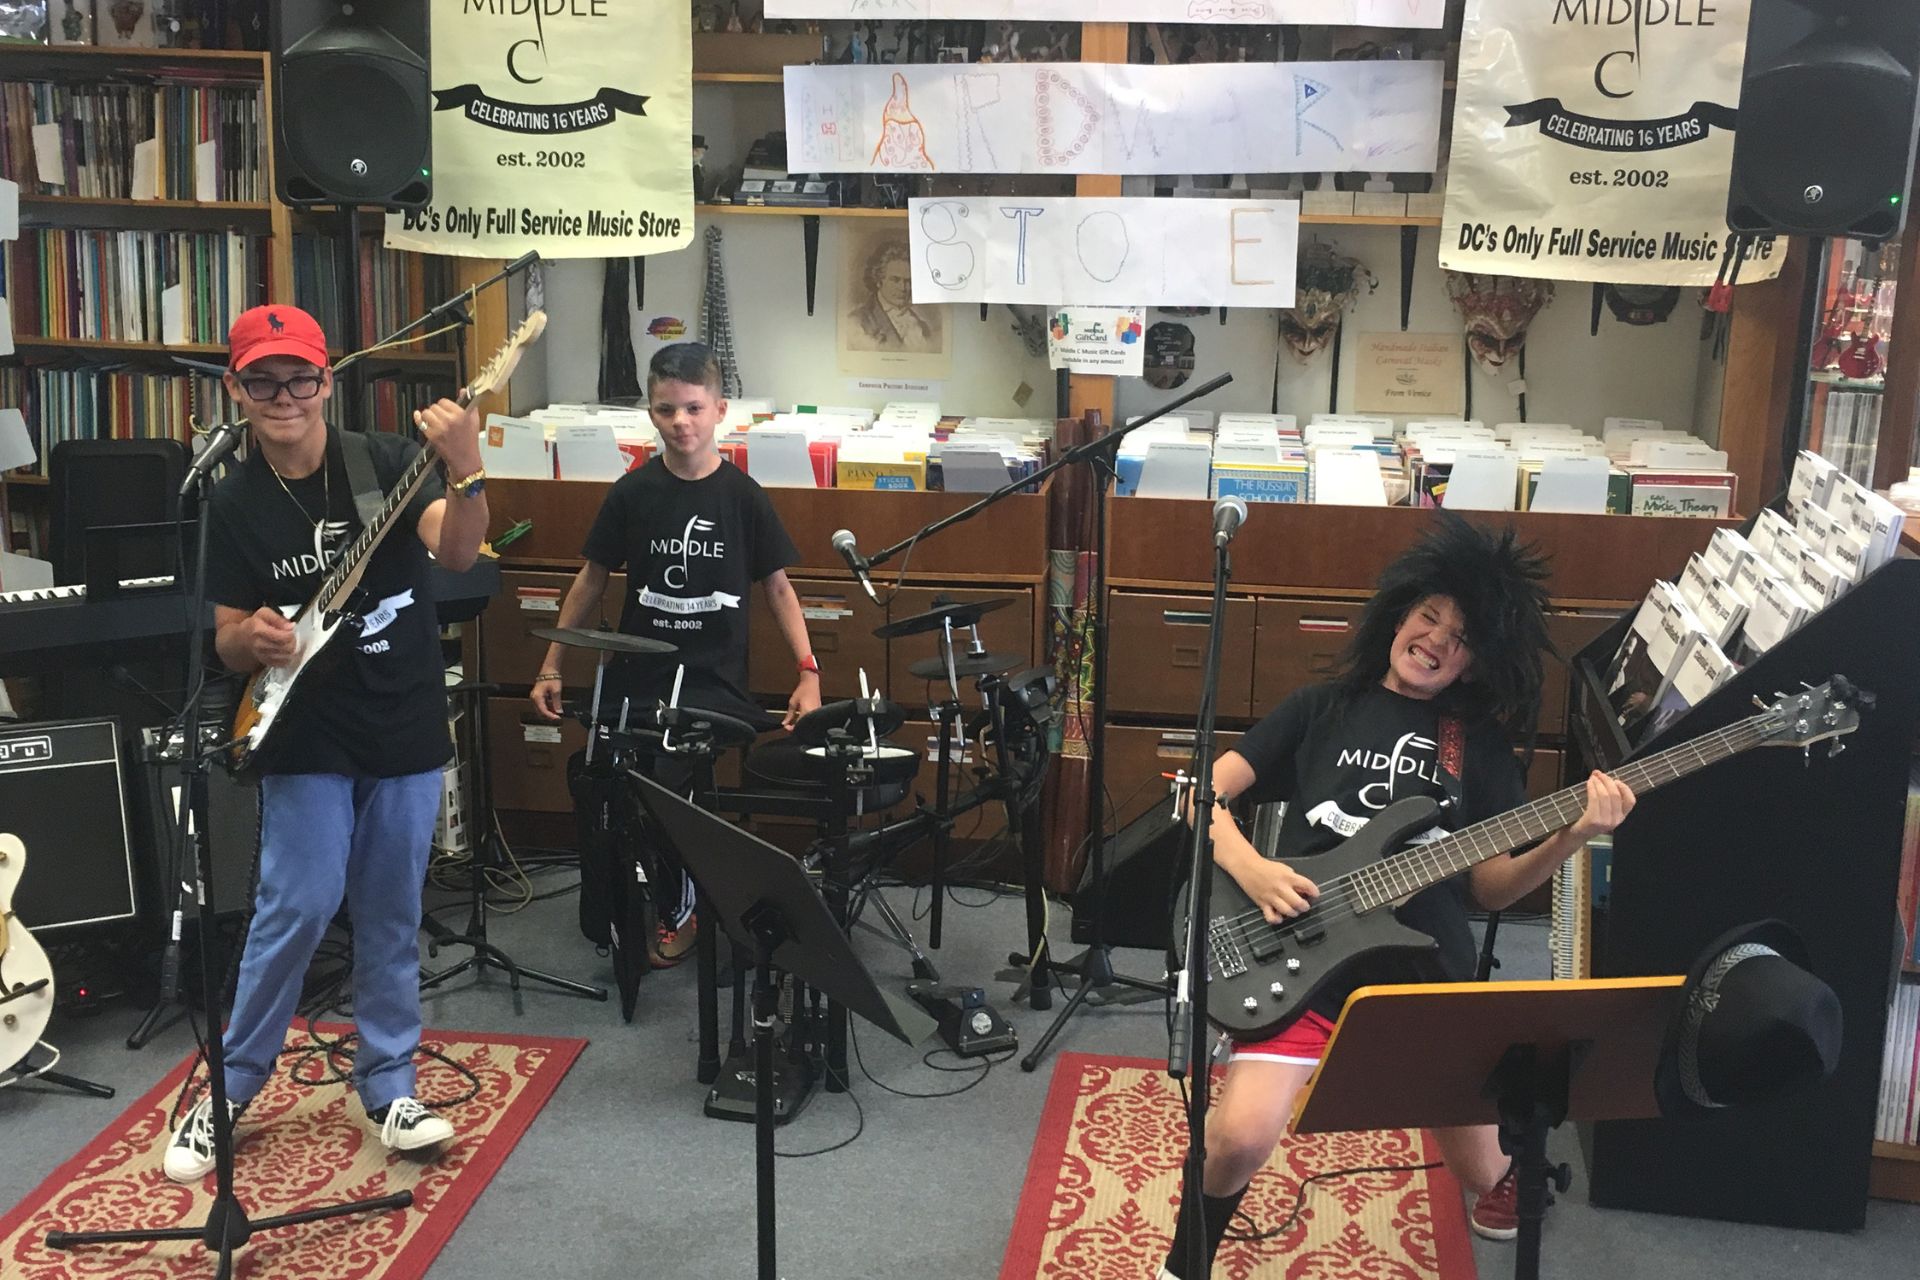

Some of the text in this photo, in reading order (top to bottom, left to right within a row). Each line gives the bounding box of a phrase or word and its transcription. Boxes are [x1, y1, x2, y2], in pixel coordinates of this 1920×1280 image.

[1552, 0, 1716, 27] MIDDLE
[507, 39, 544, 84] C
[1594, 50, 1635, 98] C
[471, 99, 609, 130] CELEBRATING 16 YEARS
[1547, 114, 1701, 148] CELEBRATING 16 YEARS
[496, 151, 586, 168] est. 2002
[1569, 170, 1669, 189] est. 2002
[403, 206, 681, 239] DC's Only Full Service Music Store
[1458, 223, 1497, 252] DC's
[1502, 226, 1545, 261] Only
[1548, 227, 1582, 257] Full
[1586, 230, 1657, 260] Service
[1661, 231, 1717, 262] Music
[1234, 480, 1297, 492] THE RUSSIAN
[1680, 498, 1719, 518] Theory
[650, 538, 725, 559] MIDDLE
[664, 565, 685, 589] C
[1801, 566, 1826, 595] hymns
[642, 595, 685, 612] CELEBRATING
[696, 599, 718, 610] YEARS
[652, 618, 703, 630] est. 2002
[1358, 782, 1390, 810] C
